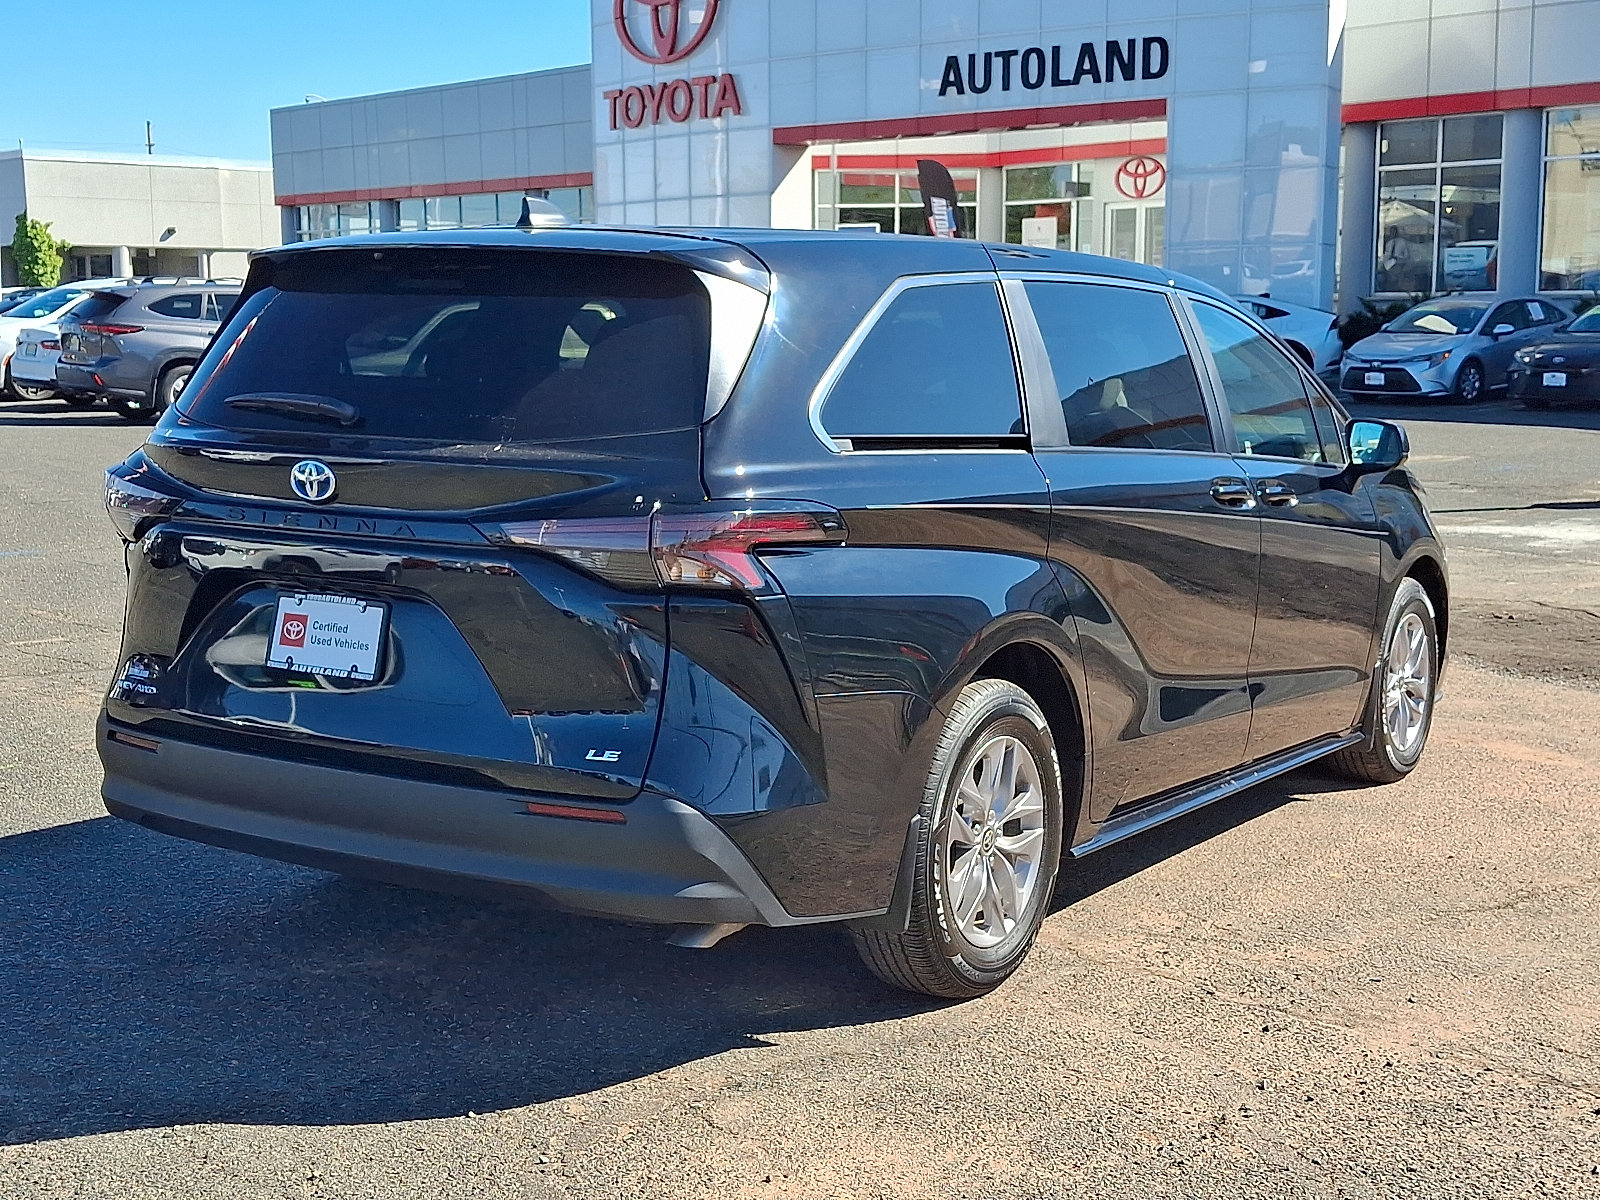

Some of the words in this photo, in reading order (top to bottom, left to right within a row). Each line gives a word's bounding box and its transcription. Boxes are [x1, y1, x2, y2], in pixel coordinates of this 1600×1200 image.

[938, 36, 1169, 96] AUTOLAND
[603, 73, 741, 131] TOYOTA
[228, 507, 417, 538] SIENNA
[312, 620, 349, 634] Certified
[310, 634, 332, 647] Used
[334, 637, 370, 651] Vehicles
[291, 663, 349, 678] AUTOLAND
[585, 749, 622, 762] LE
